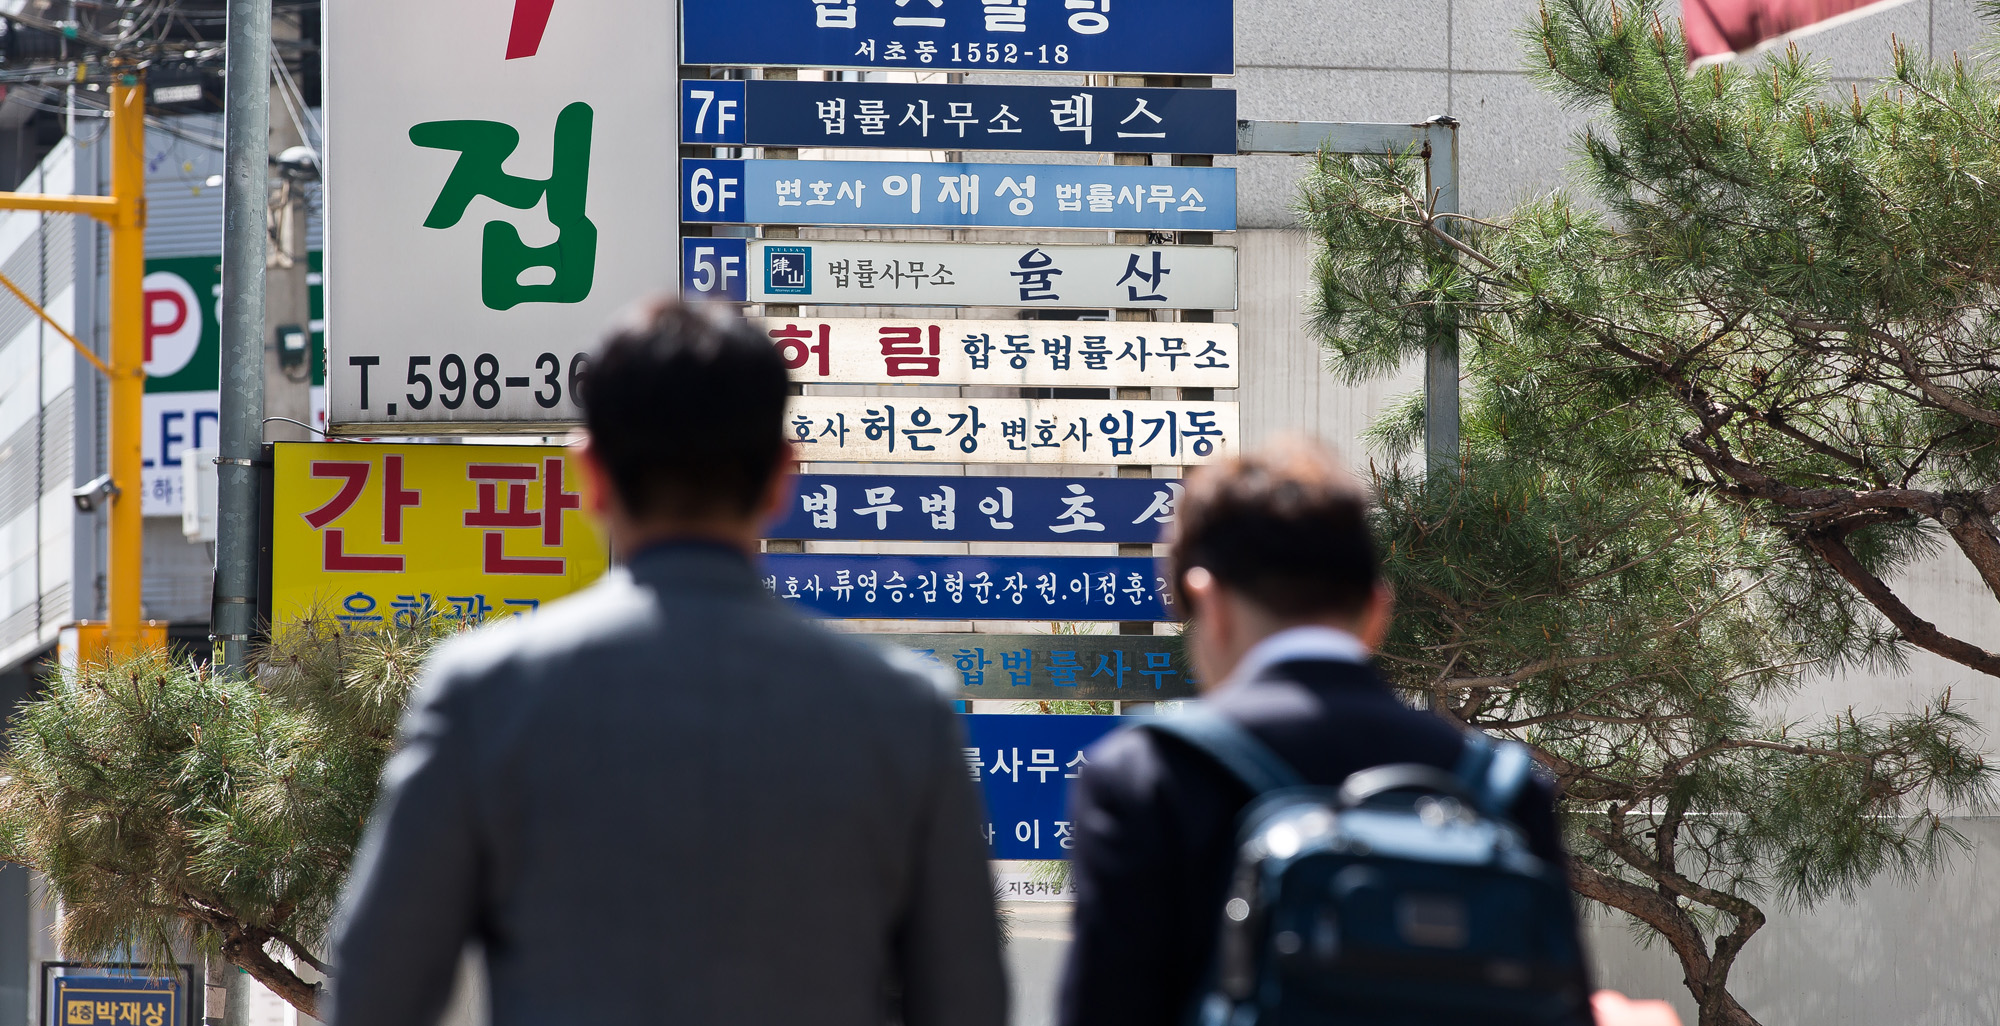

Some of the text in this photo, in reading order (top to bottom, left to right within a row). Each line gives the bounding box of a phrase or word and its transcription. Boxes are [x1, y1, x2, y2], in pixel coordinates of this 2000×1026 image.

[854, 38, 1069, 64] 서초동 1552-18
[690, 90, 737, 135] 7F
[816, 93, 1166, 145] 법률사무소 렉스
[690, 168, 738, 213] 6F
[775, 173, 1207, 216] 변호사 이재성 법률사무소
[692, 246, 740, 292] 5F
[828, 258, 955, 289] 법률사무소
[961, 332, 1230, 371] 합동법률사무소
[861, 405, 987, 454] 허은강
[1001, 416, 1093, 451] 변호사
[1099, 409, 1224, 457] 임기동
[801, 484, 1013, 530] 법무법인
